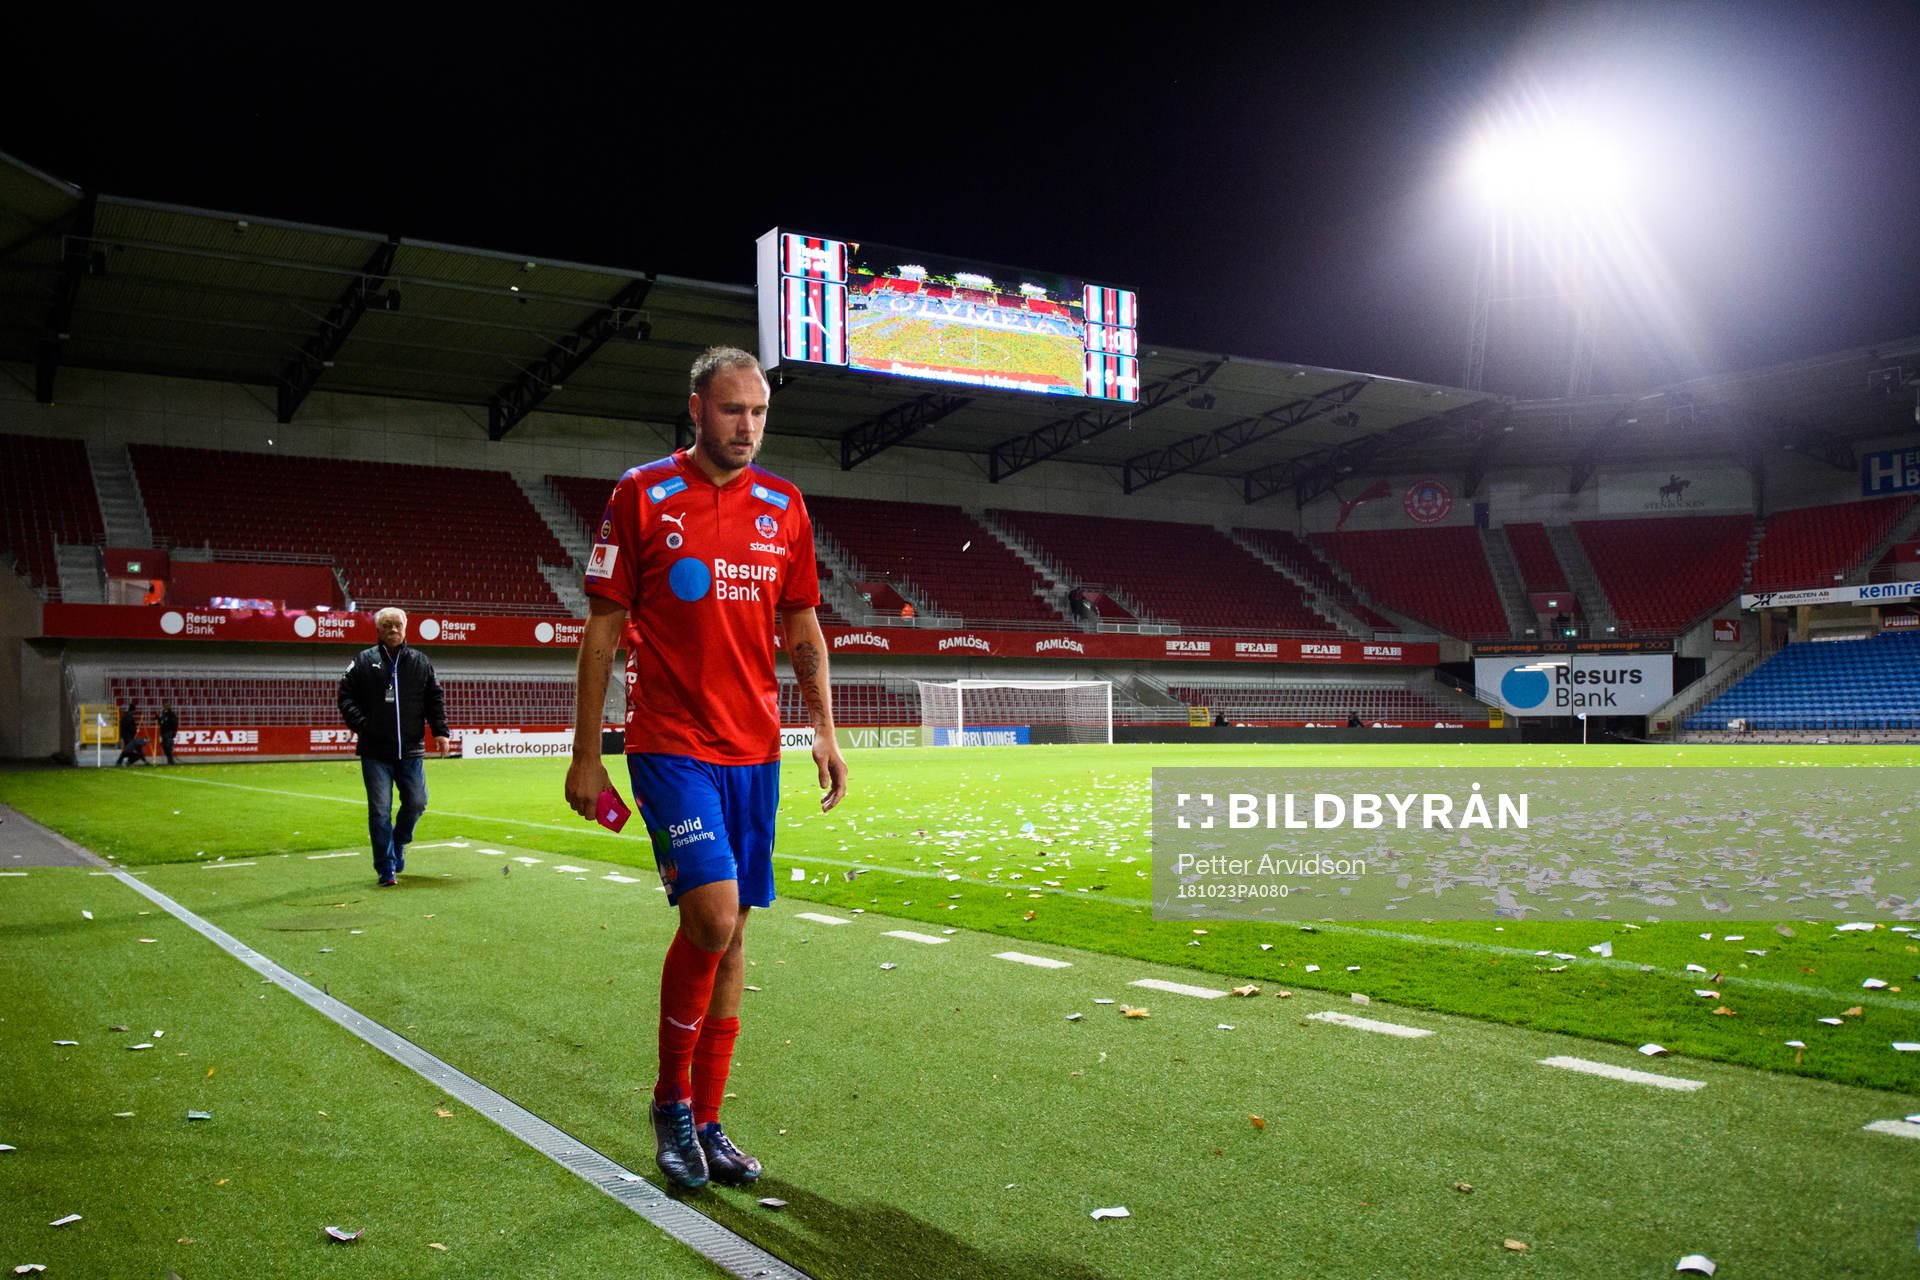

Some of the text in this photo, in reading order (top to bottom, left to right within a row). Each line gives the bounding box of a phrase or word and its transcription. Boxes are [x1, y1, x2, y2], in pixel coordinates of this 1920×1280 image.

[1871, 454, 1902, 490] H
[749, 541, 786, 556] stadium
[714, 558, 777, 582] Resurs
[716, 580, 760, 602] Bank
[186, 612, 226, 624] Resurs
[318, 615, 355, 628] Resurs
[441, 619, 476, 631] Resurs
[186, 624, 214, 635] Bank
[318, 627, 345, 638] Bank
[441, 631, 466, 641] Bank
[555, 633, 578, 643] Bank
[834, 631, 889, 650] RAMLÖSA
[938, 634, 990, 652] RAMLÖSA
[1035, 637, 1084, 654] RAMLÖSA
[1171, 641, 1206, 651] PEAB
[1241, 643, 1273, 653] PEAB
[1306, 644, 1337, 654] PEAB
[1368, 646, 1397, 656] PEAB
[1555, 665, 1642, 685] Resurs
[1556, 687, 1617, 707] Bank
[177, 730, 248, 744] PEAB
[321, 729, 358, 743] PE
[848, 729, 916, 748] VINGE
[474, 742, 573, 755] elektrokoppar
[669, 816, 702, 838] Solid
[672, 831, 716, 848] Försäkring
